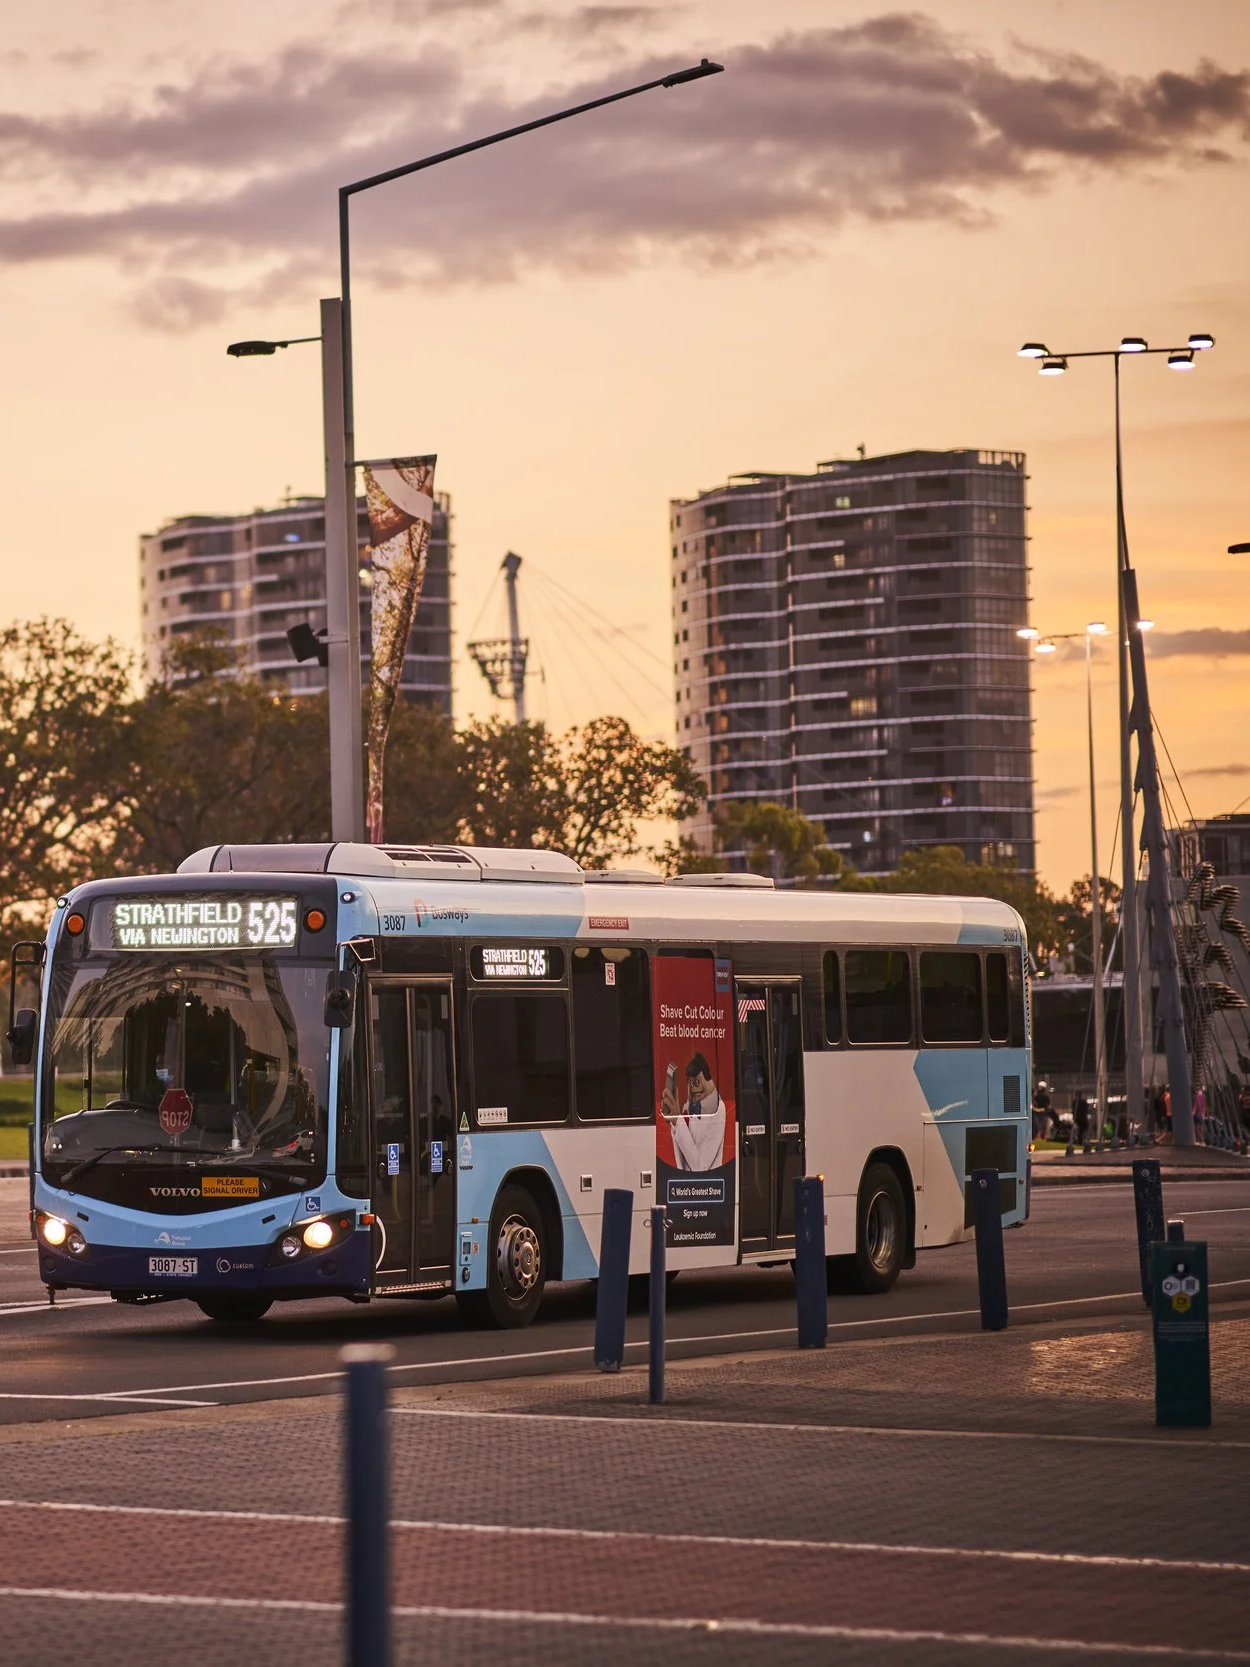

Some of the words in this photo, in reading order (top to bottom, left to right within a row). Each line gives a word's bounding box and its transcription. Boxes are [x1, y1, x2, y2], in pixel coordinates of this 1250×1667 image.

[114, 902, 242, 925] STRATHFIELD
[248, 900, 297, 943] 525
[383, 915, 406, 931] 3087
[591, 918, 617, 927] EMERGENCY
[119, 927, 147, 945] VIA
[151, 927, 240, 945] NEWINGTON
[482, 949, 527, 963] STRATHFIELD
[528, 949, 546, 976] 525
[485, 964, 495, 976] VIA
[496, 964, 528, 976] NEWINGTON
[660, 1004, 683, 1019] Shave
[684, 1005, 698, 1019] Cut
[699, 1005, 725, 1020] Colour
[660, 1023, 678, 1038] Beat
[678, 1024, 699, 1038] blood
[700, 1027, 726, 1039] cancer
[216, 1178, 244, 1186] PLEASE
[150, 1187, 201, 1197] VOLVO
[203, 1186, 230, 1194] SIGNAL
[231, 1187, 258, 1195] DRIVER
[676, 1187, 691, 1196] World's
[691, 1187, 708, 1196] Greatest
[709, 1187, 722, 1196] Shave
[683, 1209, 692, 1219] Sign
[694, 1231, 717, 1240] Foundation
